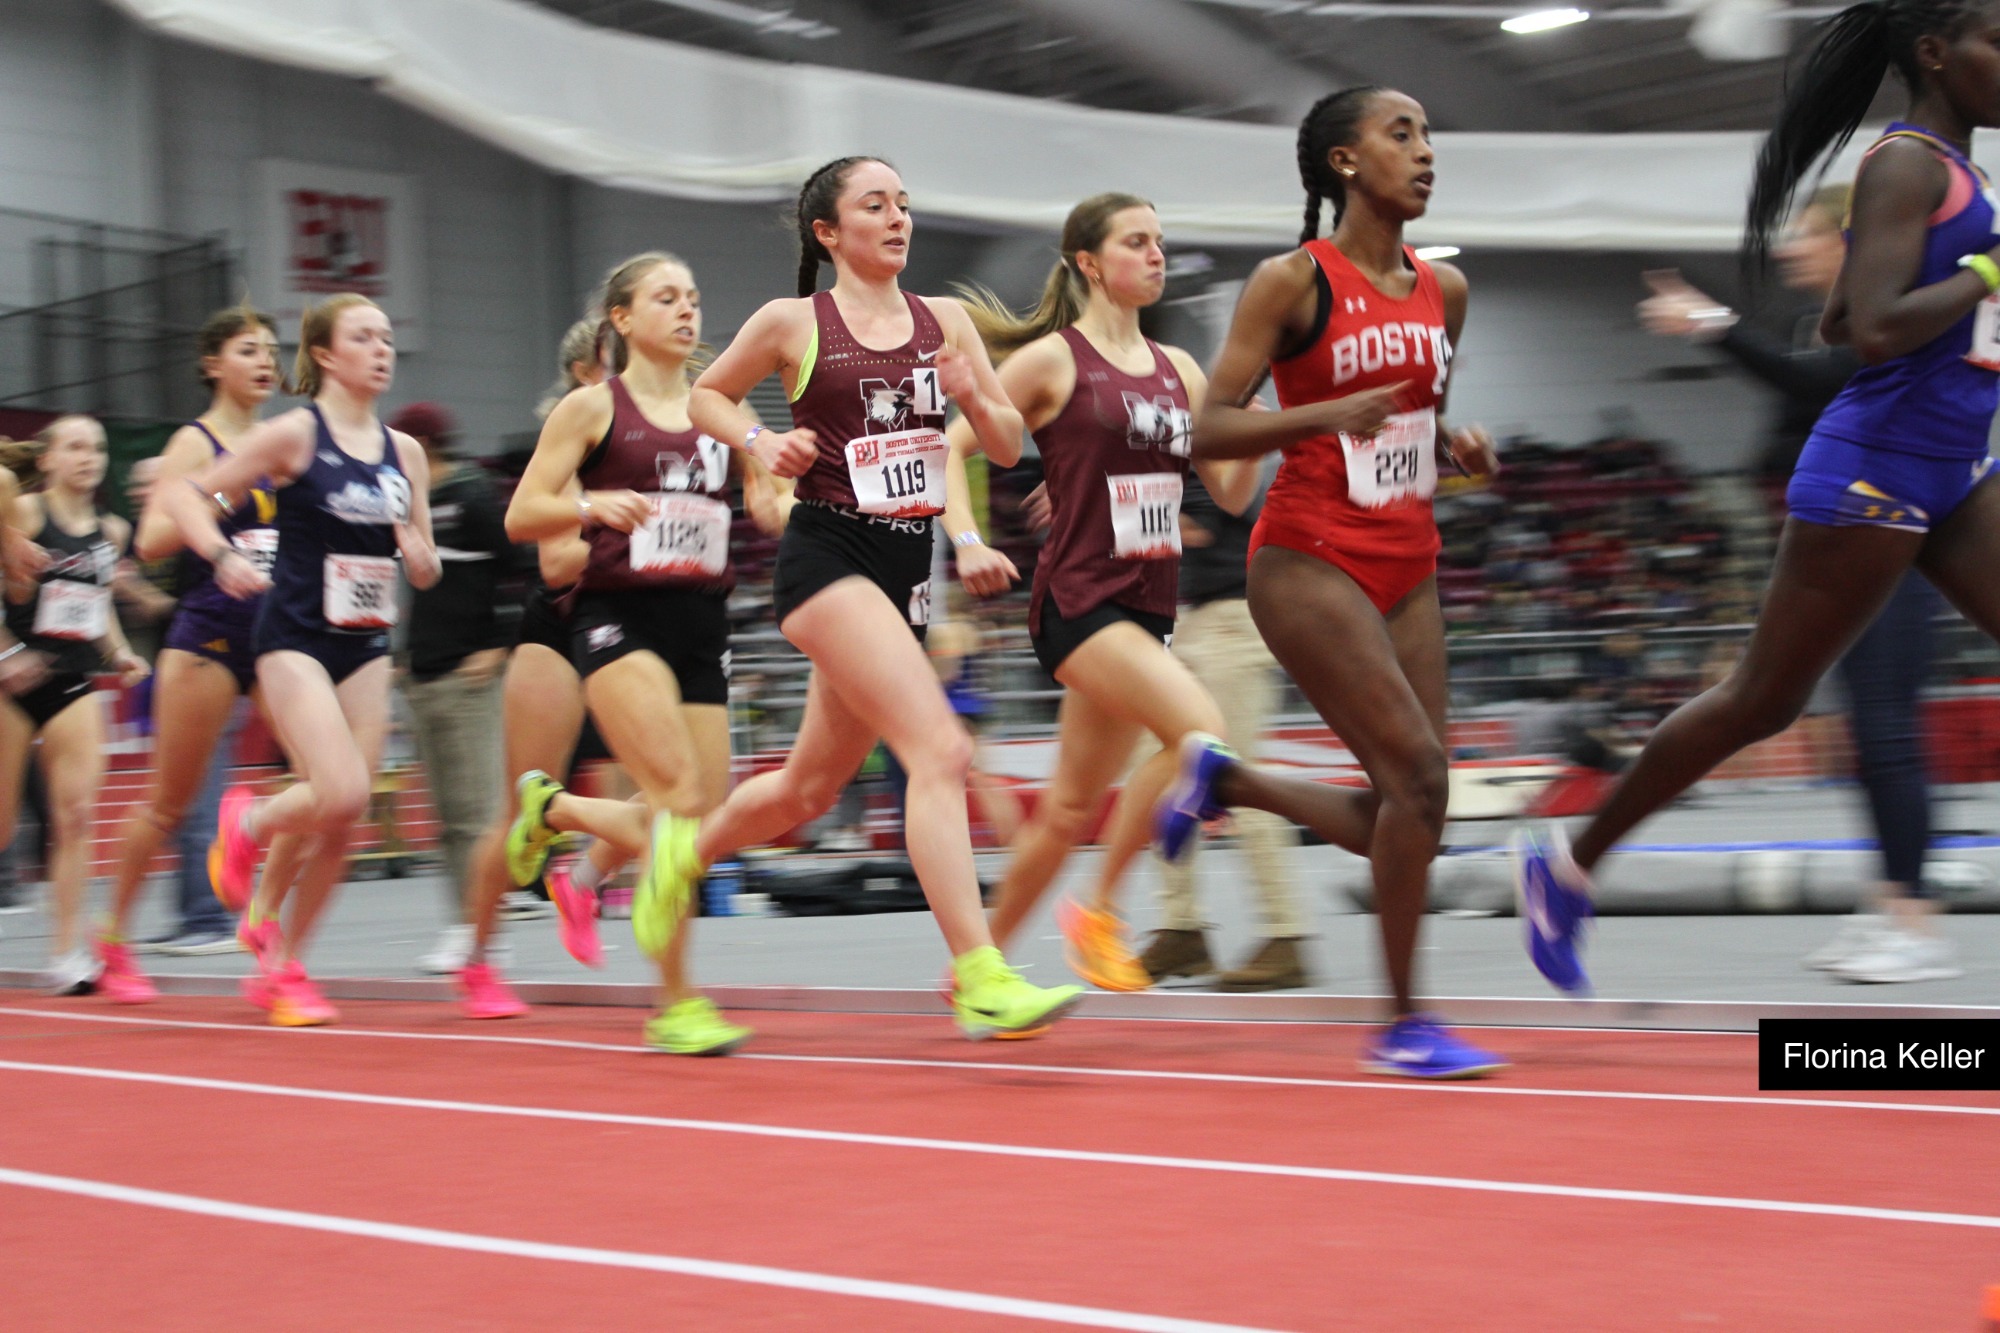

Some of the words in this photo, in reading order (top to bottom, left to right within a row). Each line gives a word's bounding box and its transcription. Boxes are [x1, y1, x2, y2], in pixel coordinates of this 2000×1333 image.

[852, 439, 879, 462] BU
[881, 458, 926, 499] 1119
[867, 513, 925, 534] PRO
